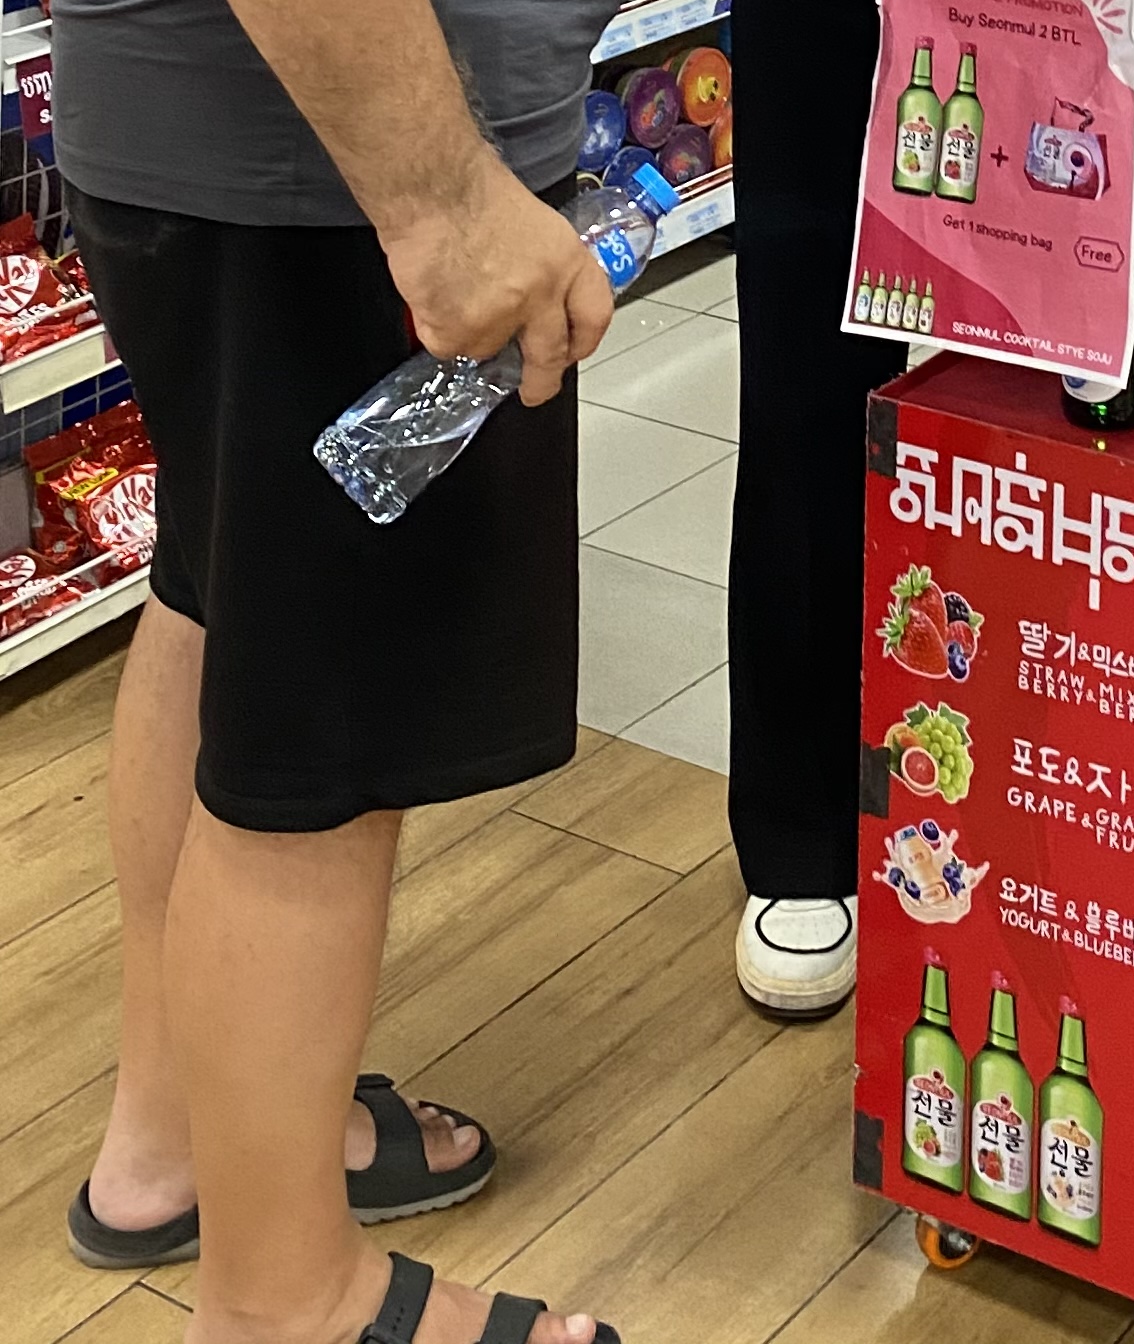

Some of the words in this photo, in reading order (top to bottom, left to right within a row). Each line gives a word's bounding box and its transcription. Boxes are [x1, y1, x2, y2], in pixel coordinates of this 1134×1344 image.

[948, 8, 975, 28] Buy
[978, 12, 1036, 36] Seonmul
[1038, 24, 1048, 39] 2
[1051, 27, 1082, 46] BTL
[943, 214, 965, 230] Get
[976, 223, 1028, 247] shopping
[1030, 233, 1053, 252] bag
[1081, 244, 1113, 263] Free
[1018, 674, 1083, 705] BERRY
[1019, 660, 1085, 689] STRAW
[1007, 787, 1076, 824] GRAPE
[1081, 812, 1094, 829] &
[999, 877, 1058, 917] 요거트
